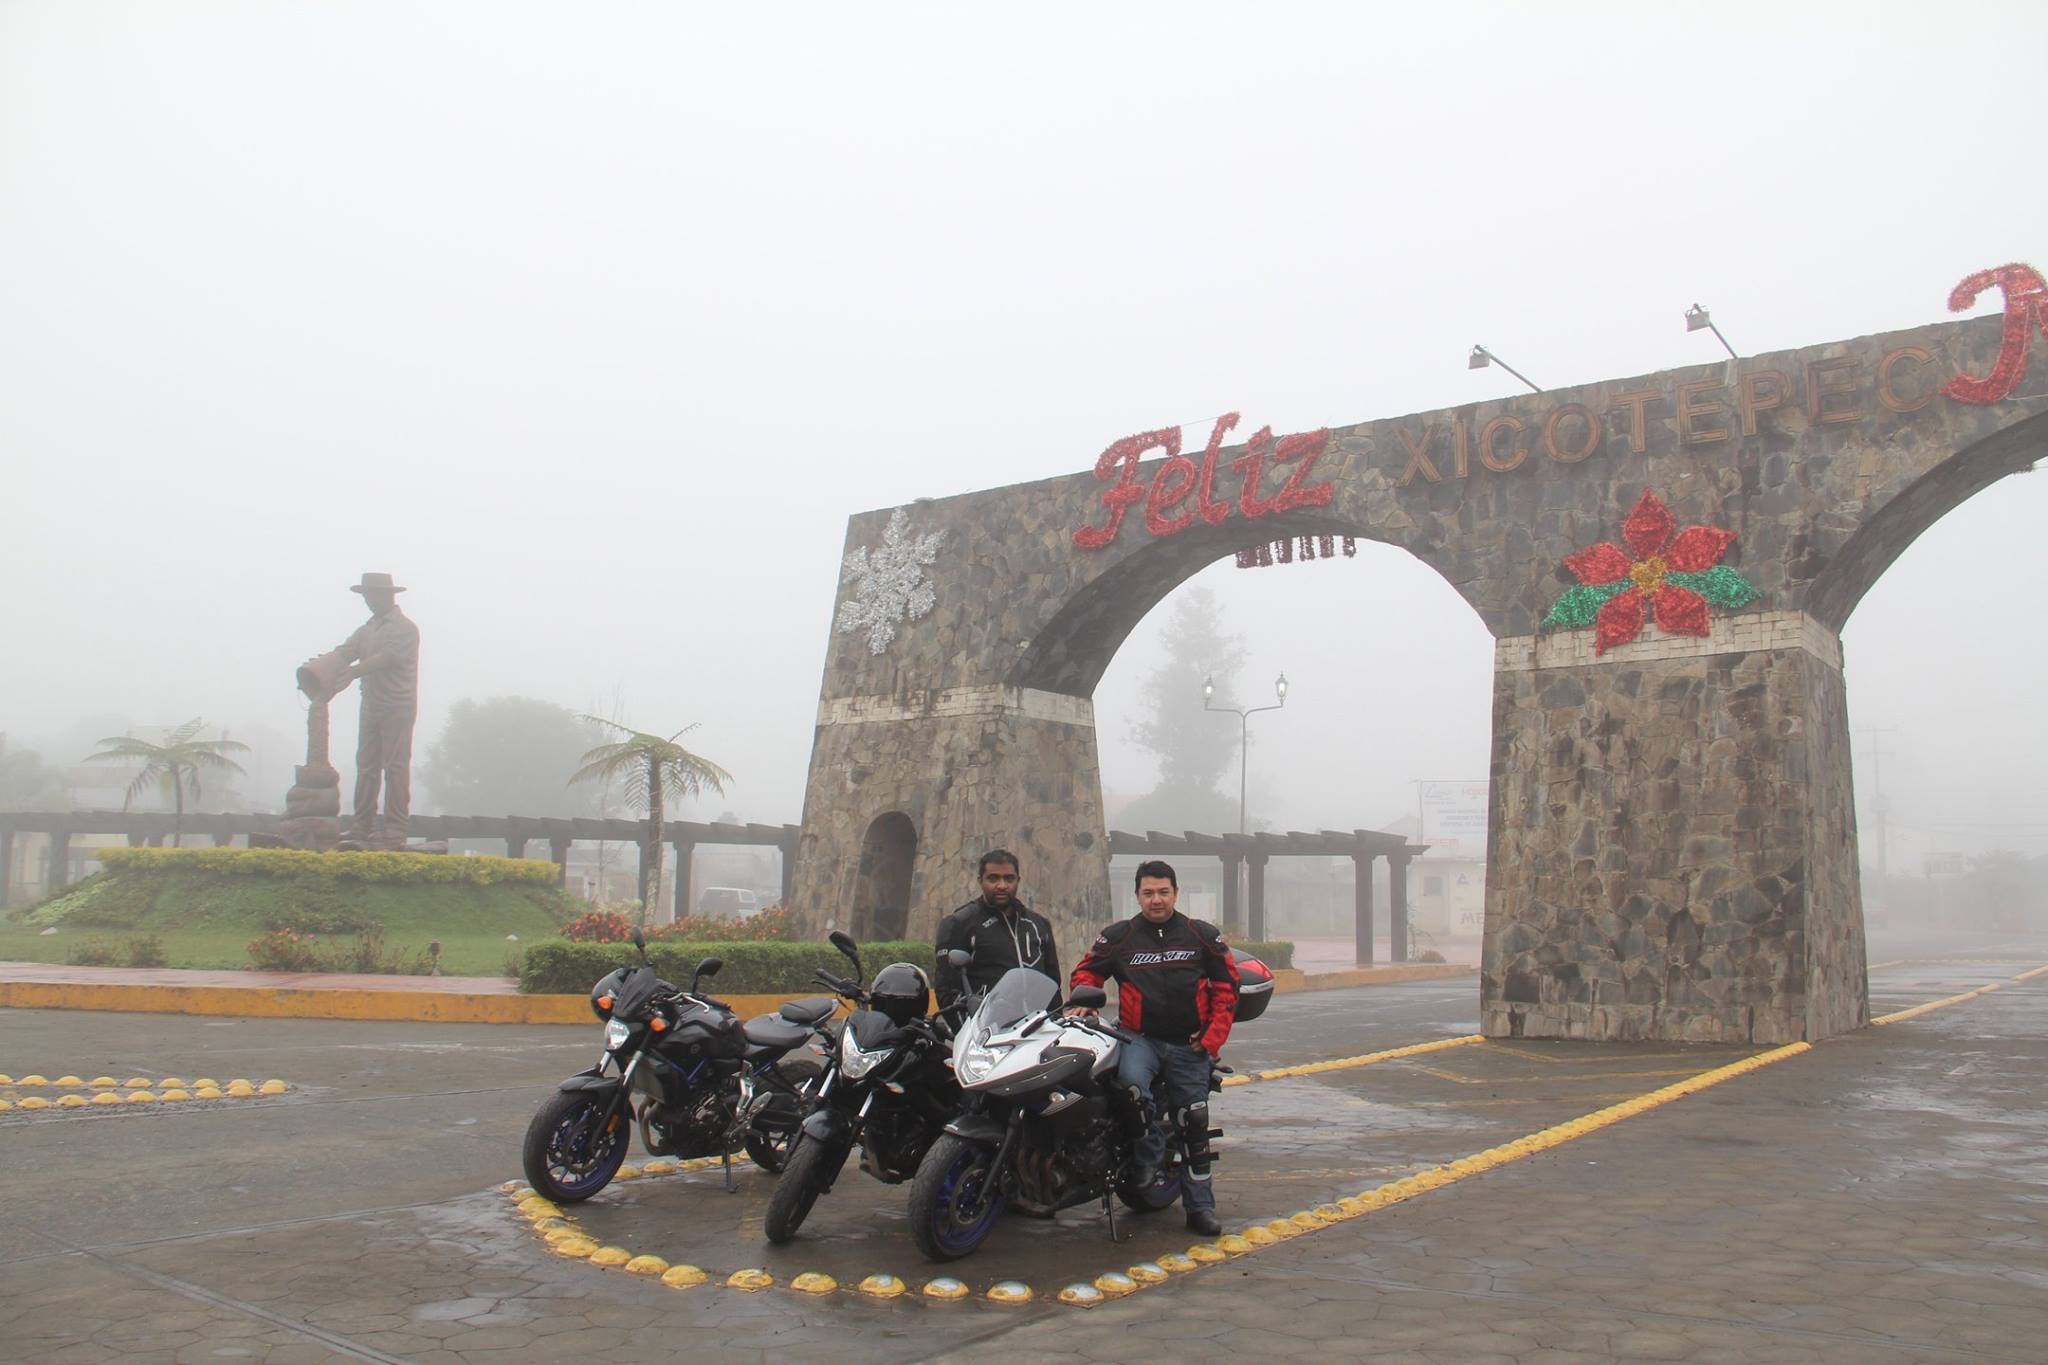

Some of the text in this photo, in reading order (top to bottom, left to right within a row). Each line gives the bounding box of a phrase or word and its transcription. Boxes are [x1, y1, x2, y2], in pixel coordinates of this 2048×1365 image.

[1072, 411, 1334, 548] Feliz
[1400, 346, 1936, 487] XICOTEPEC
[1130, 950, 1196, 965] ROCKET
